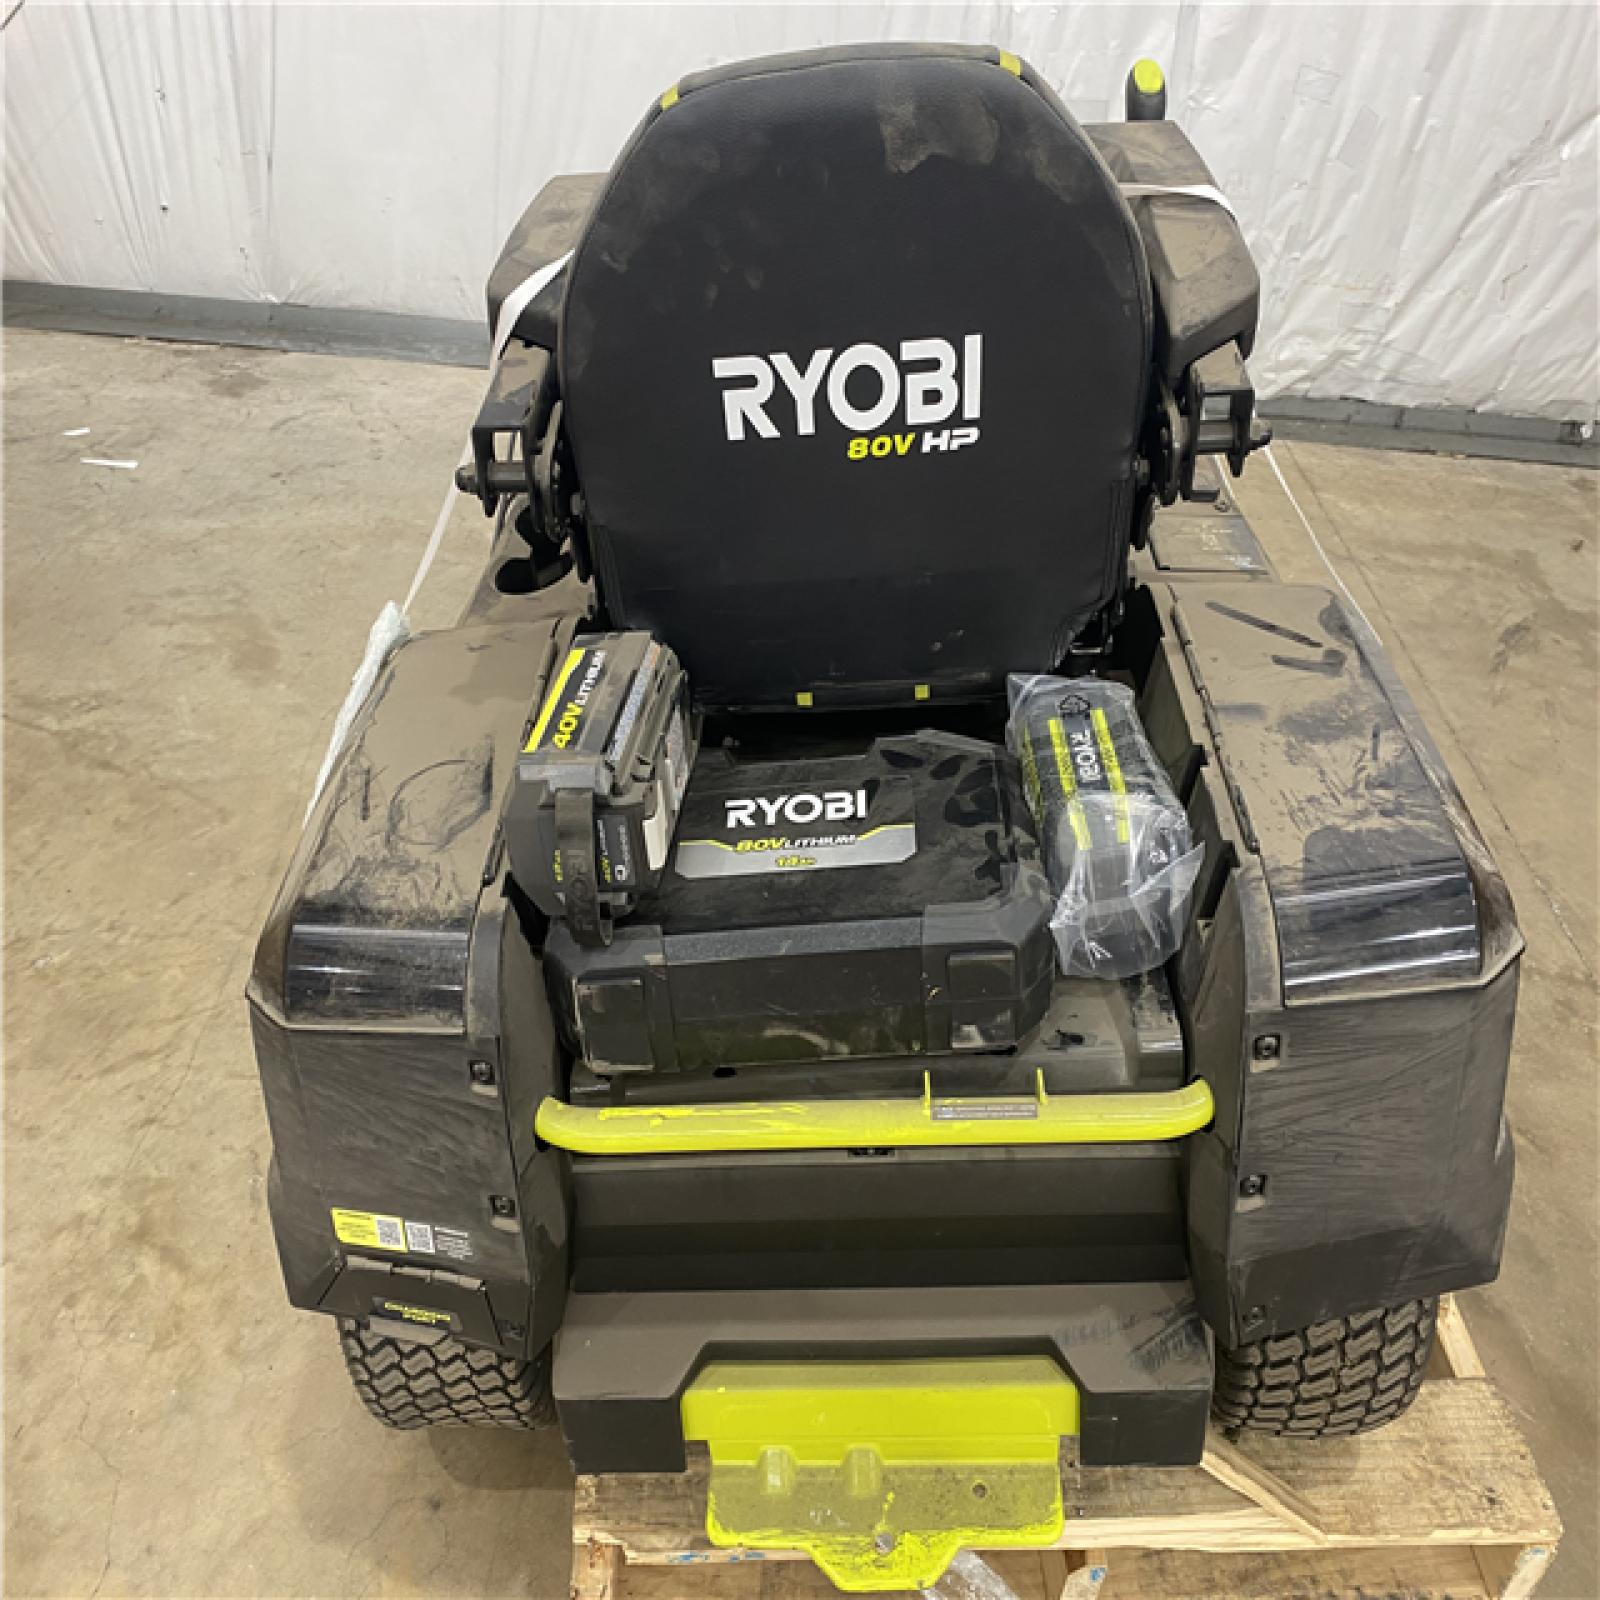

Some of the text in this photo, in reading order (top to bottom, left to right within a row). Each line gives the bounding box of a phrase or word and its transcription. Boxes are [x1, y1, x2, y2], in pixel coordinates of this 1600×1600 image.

[712, 333, 982, 441] RYOBI
[847, 427, 981, 459] 80V HP
[724, 789, 867, 829] RYOBI
